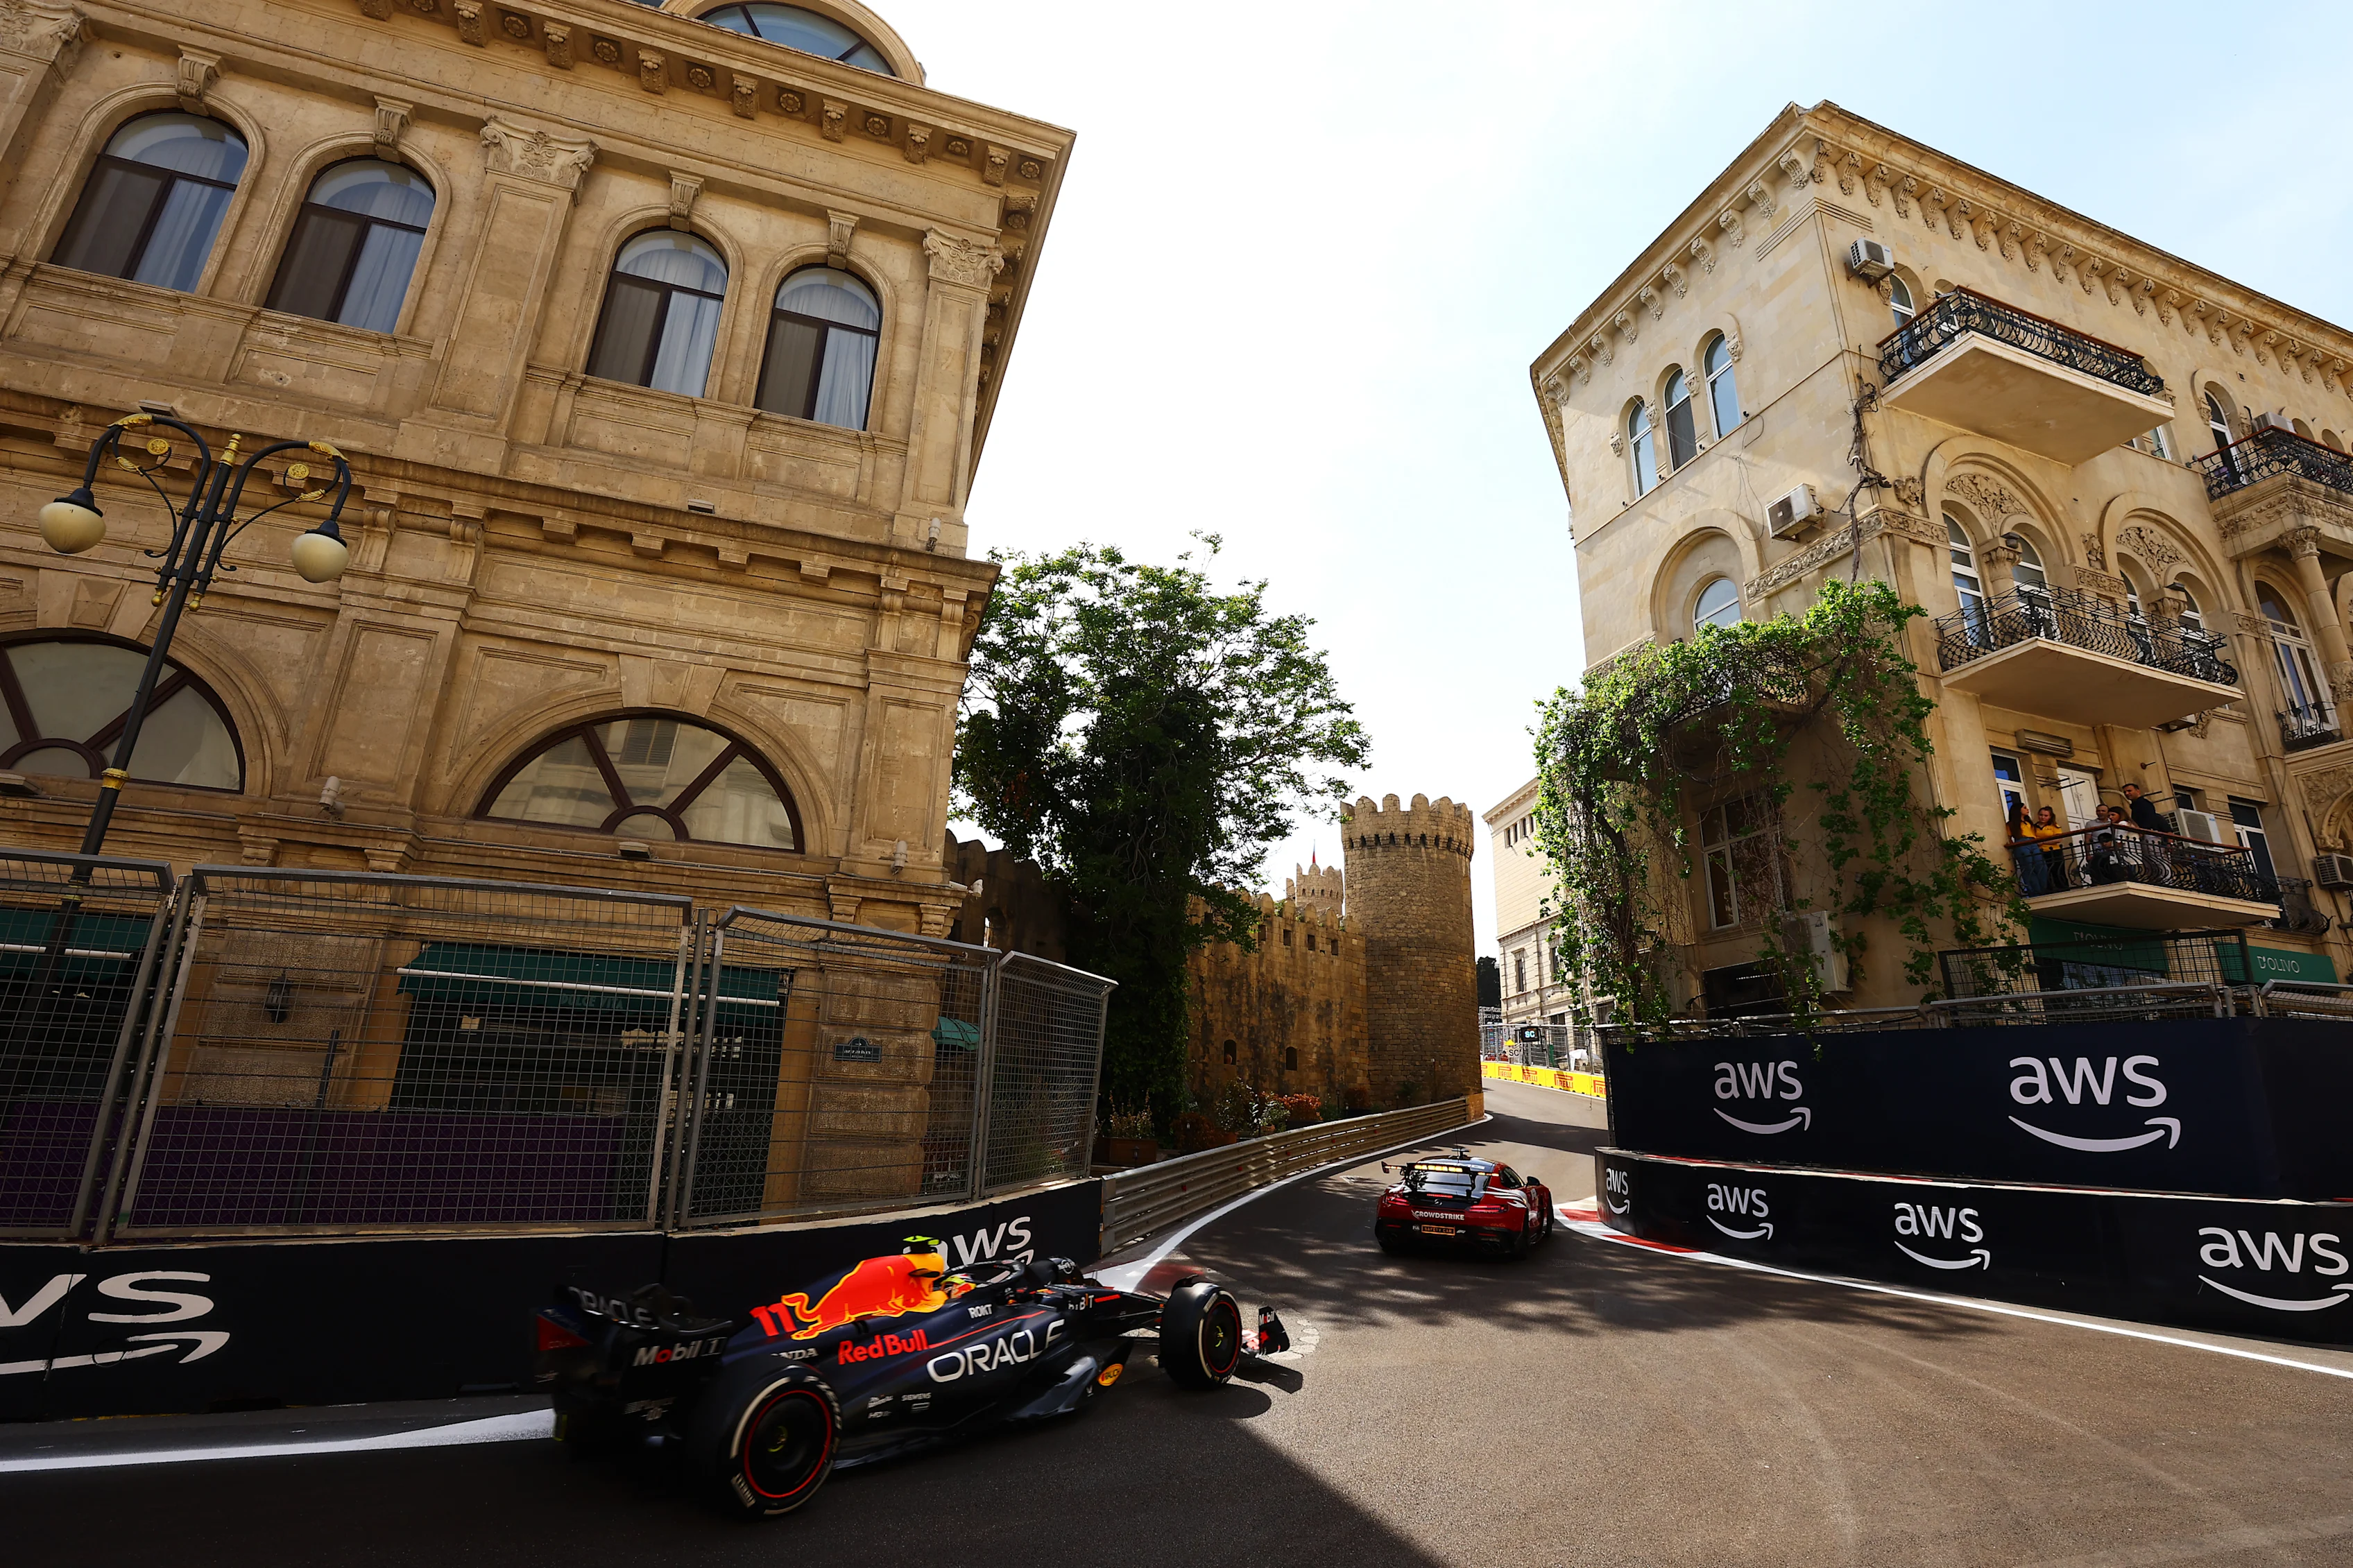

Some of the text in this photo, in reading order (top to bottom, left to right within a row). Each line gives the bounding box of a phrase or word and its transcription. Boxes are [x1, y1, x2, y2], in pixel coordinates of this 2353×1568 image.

[2257, 956, 2300, 974] D'OLIVO
[561, 994, 624, 1010] DULCE VITA
[1498, 1066, 1512, 1078] PIRELLI
[1523, 1069, 1538, 1082] PIRELLI
[1554, 1073, 1573, 1089] PIRELLI
[1714, 1060, 1803, 1100] aws
[2009, 1055, 2167, 1108] aws
[1606, 1168, 1629, 1196] aws
[1707, 1183, 1769, 1218] aws
[1415, 1210, 1465, 1221] CROWDSTRIKE
[1894, 1203, 1983, 1243] aws
[2198, 1227, 2349, 1276] aws
[748, 1302, 798, 1337] 11
[968, 1304, 993, 1319] ROKT
[1258, 1310, 1275, 1326] Mobil
[632, 1339, 703, 1368] Mobil
[926, 1318, 1066, 1383] ORACLE
[900, 1392, 932, 1402] SIEMENS
